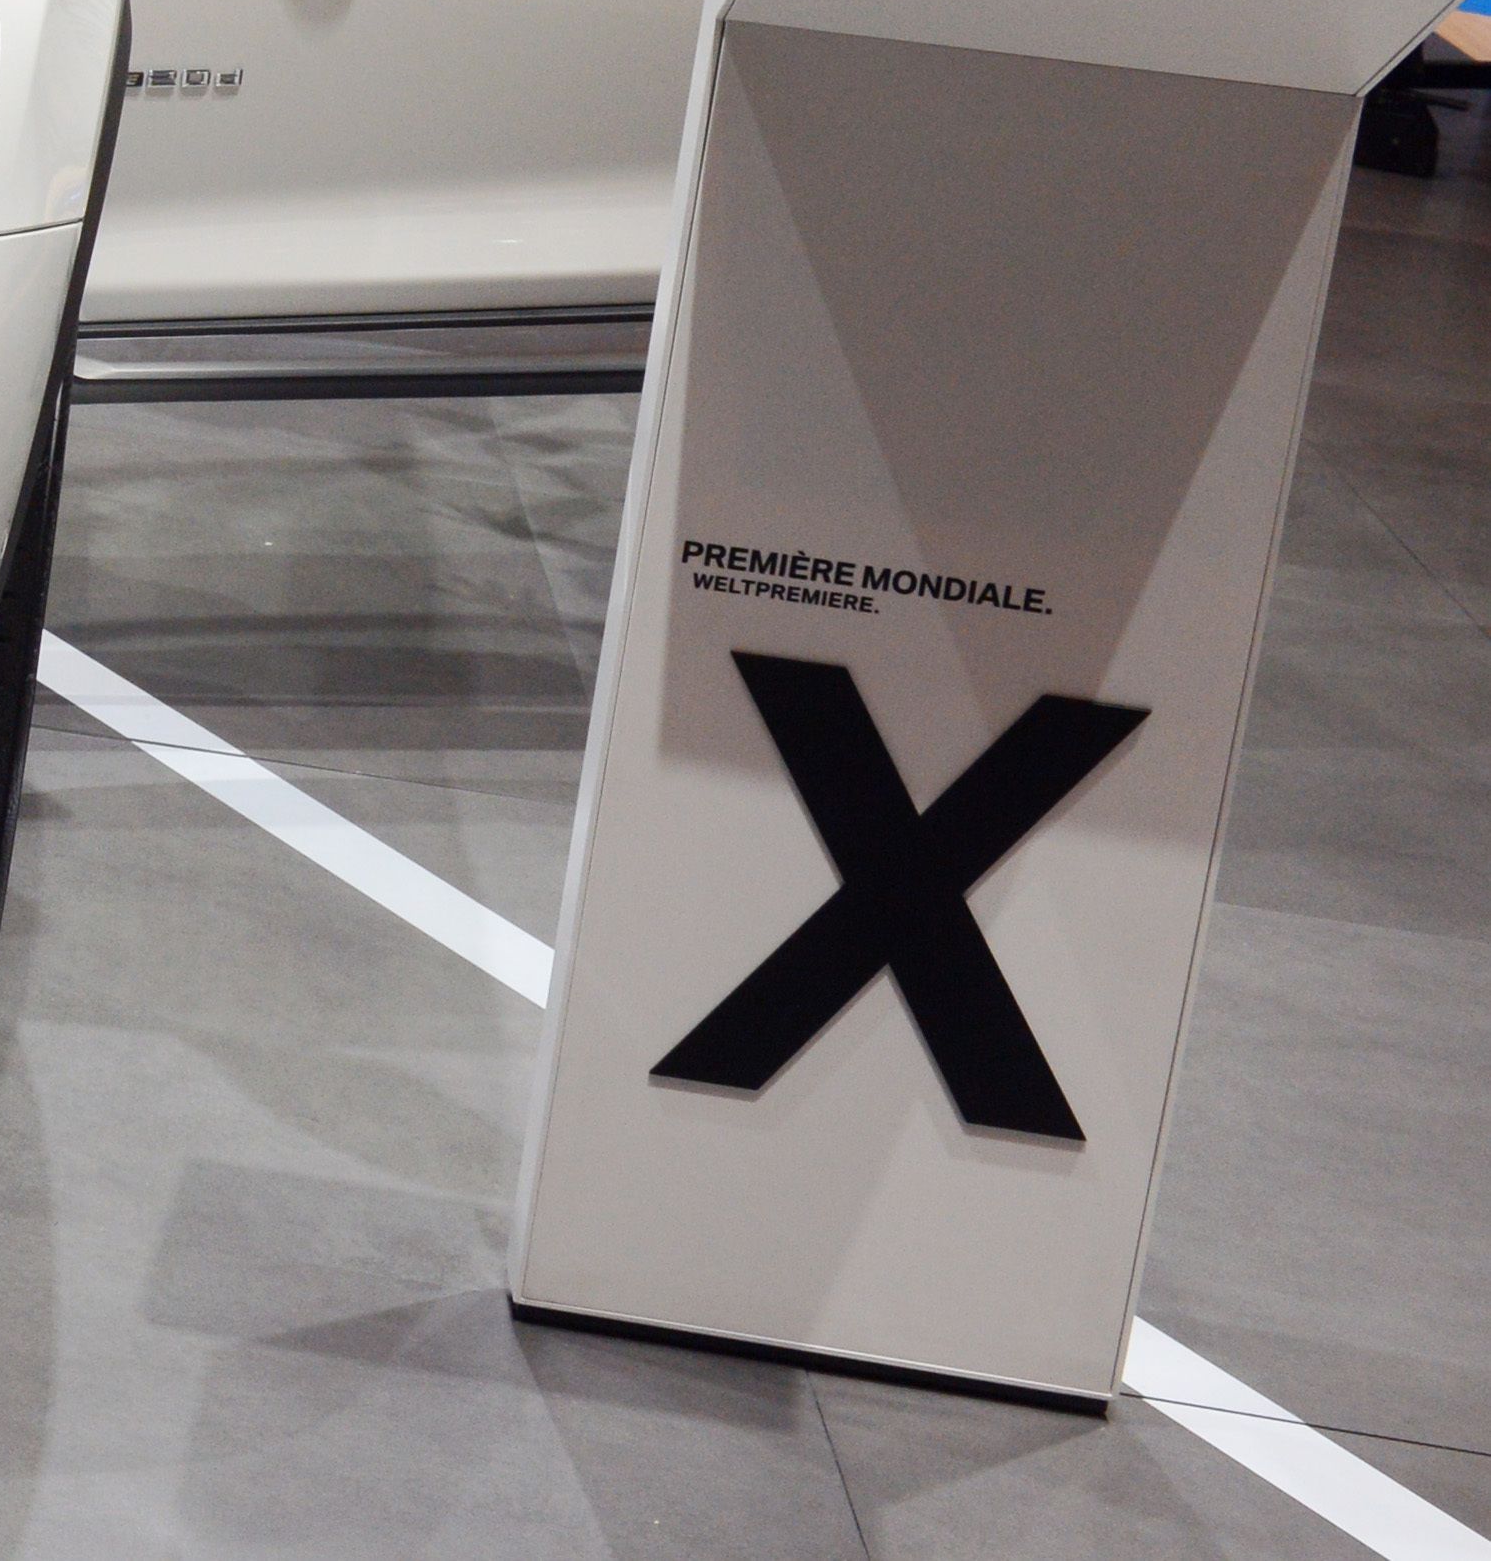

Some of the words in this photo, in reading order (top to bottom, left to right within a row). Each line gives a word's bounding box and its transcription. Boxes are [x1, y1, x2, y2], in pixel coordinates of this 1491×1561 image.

[681, 540, 856, 587] PREMIÈRE
[860, 565, 1054, 615] MONDIALE.
[692, 572, 880, 614] WELTPREMIERE.
[648, 648, 1153, 1142] X
